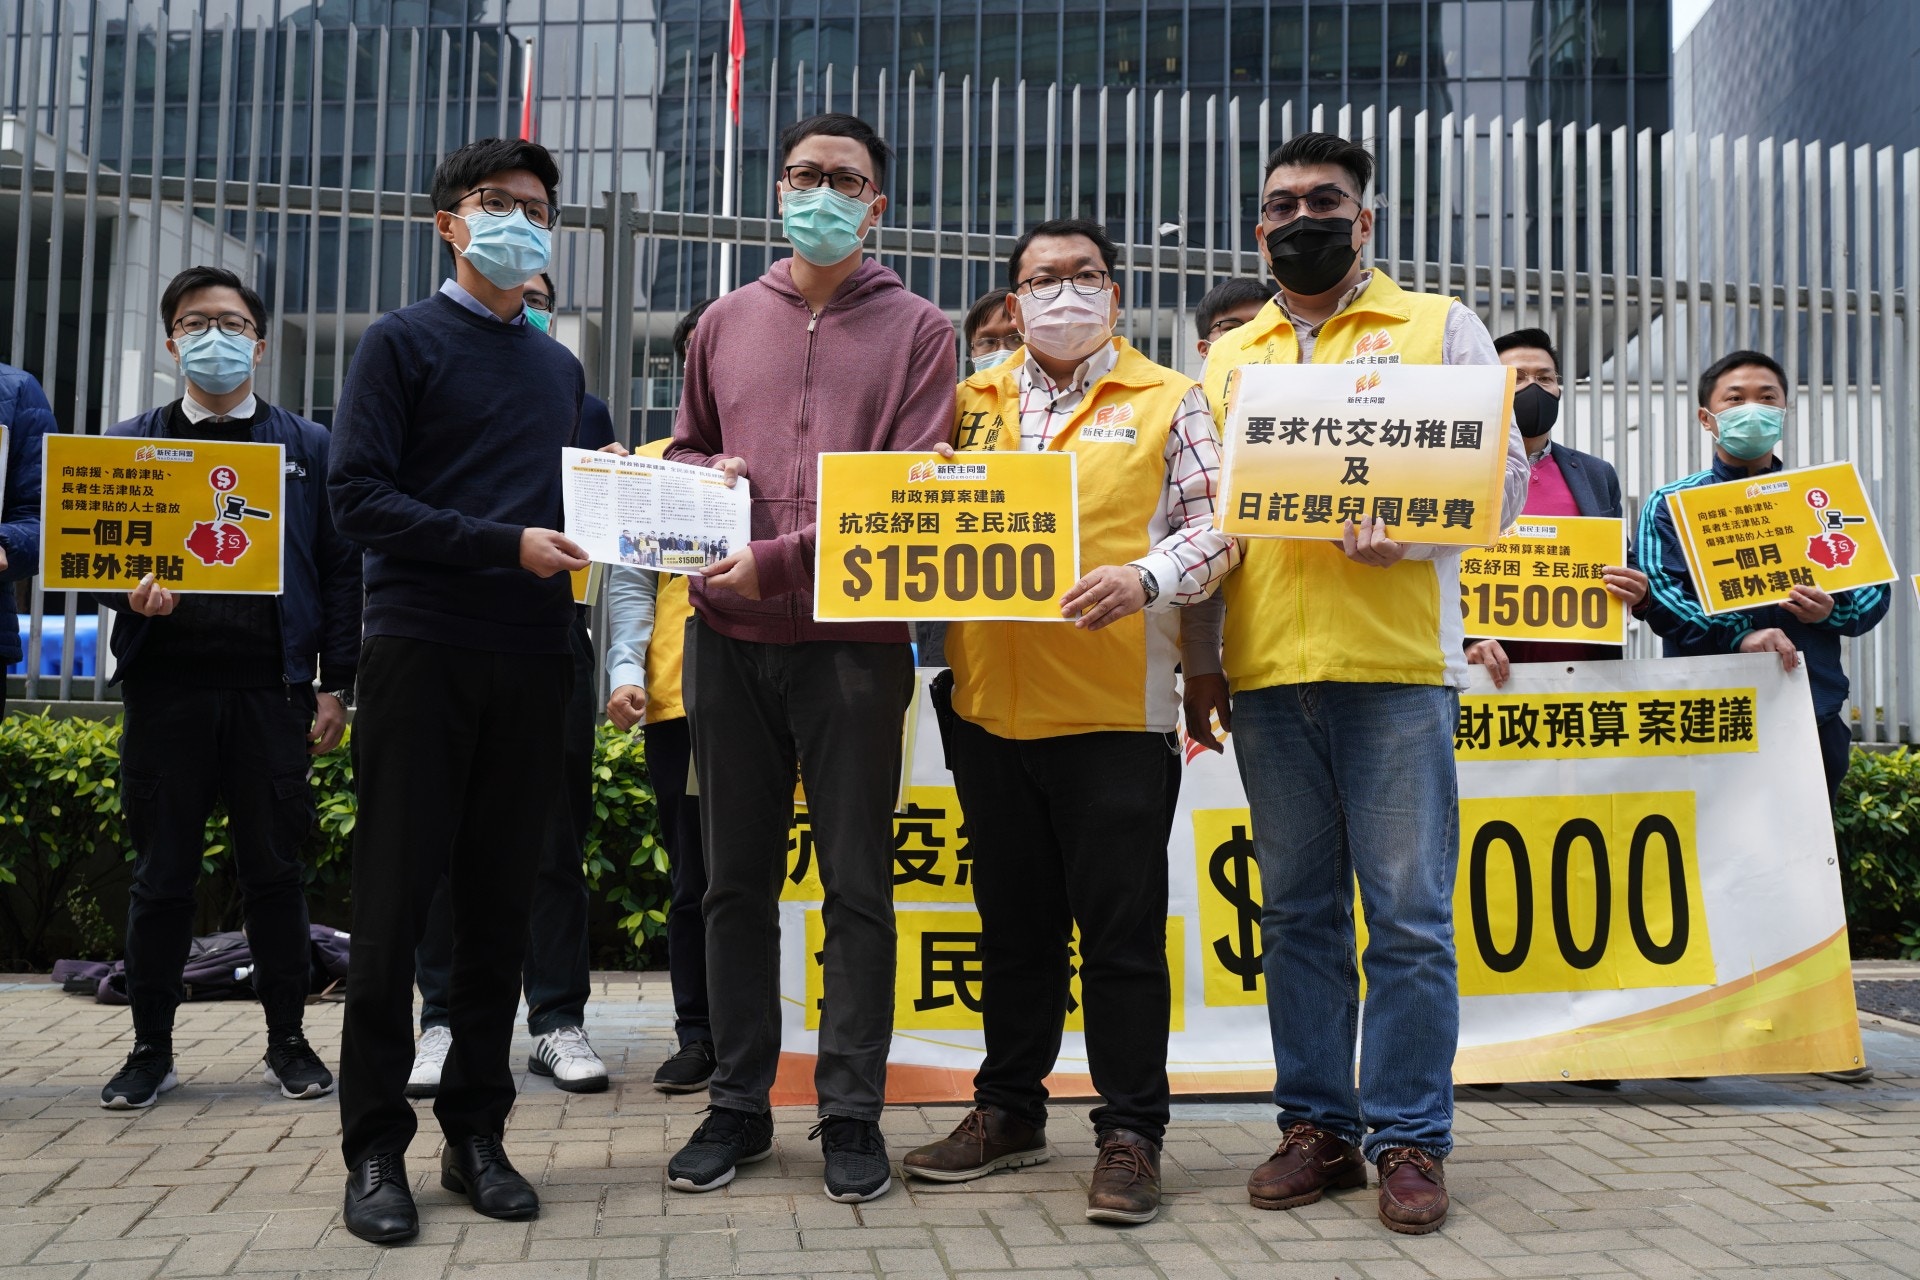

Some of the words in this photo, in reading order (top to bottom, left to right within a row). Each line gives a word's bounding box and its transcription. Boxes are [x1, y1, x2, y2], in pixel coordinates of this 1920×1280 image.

[1347, 396, 1385, 404] 新民主同盟
[953, 410, 990, 452] 任
[1082, 427, 1136, 439] 新民主同盟
[1245, 416, 1483, 449] 要求代交幼稚園
[157, 449, 193, 457] 新民主同盟
[62, 465, 173, 481] 向綜援、高齡津貼、
[937, 465, 986, 474] 新民主同盟
[1340, 456, 1370, 486] 及
[61, 483, 154, 497] 長者生活津貼及
[891, 489, 1006, 504] 財政預算案建議
[61, 499, 180, 514] 傷殘津貼的人士發放
[1238, 492, 1475, 529] 日託嬰兒園學費
[61, 519, 152, 547] 一個月
[839, 512, 940, 534] 抗疫紓困
[955, 511, 1057, 534] 全民派錢
[1519, 525, 1556, 533] 新民主同盟
[1702, 516, 1771, 535] 長者生活津貼及
[1706, 525, 1795, 548] 傷殘津貼的人士發放
[60, 552, 184, 581] 額外津貼
[678, 556, 704, 564] $15000
[1460, 558, 1521, 576] 疫紓困
[1712, 543, 1783, 570] 一個月
[842, 543, 1056, 602] $15000
[1718, 566, 1816, 601] 額外津貼
[1454, 696, 1754, 750] 財政預算案建議
